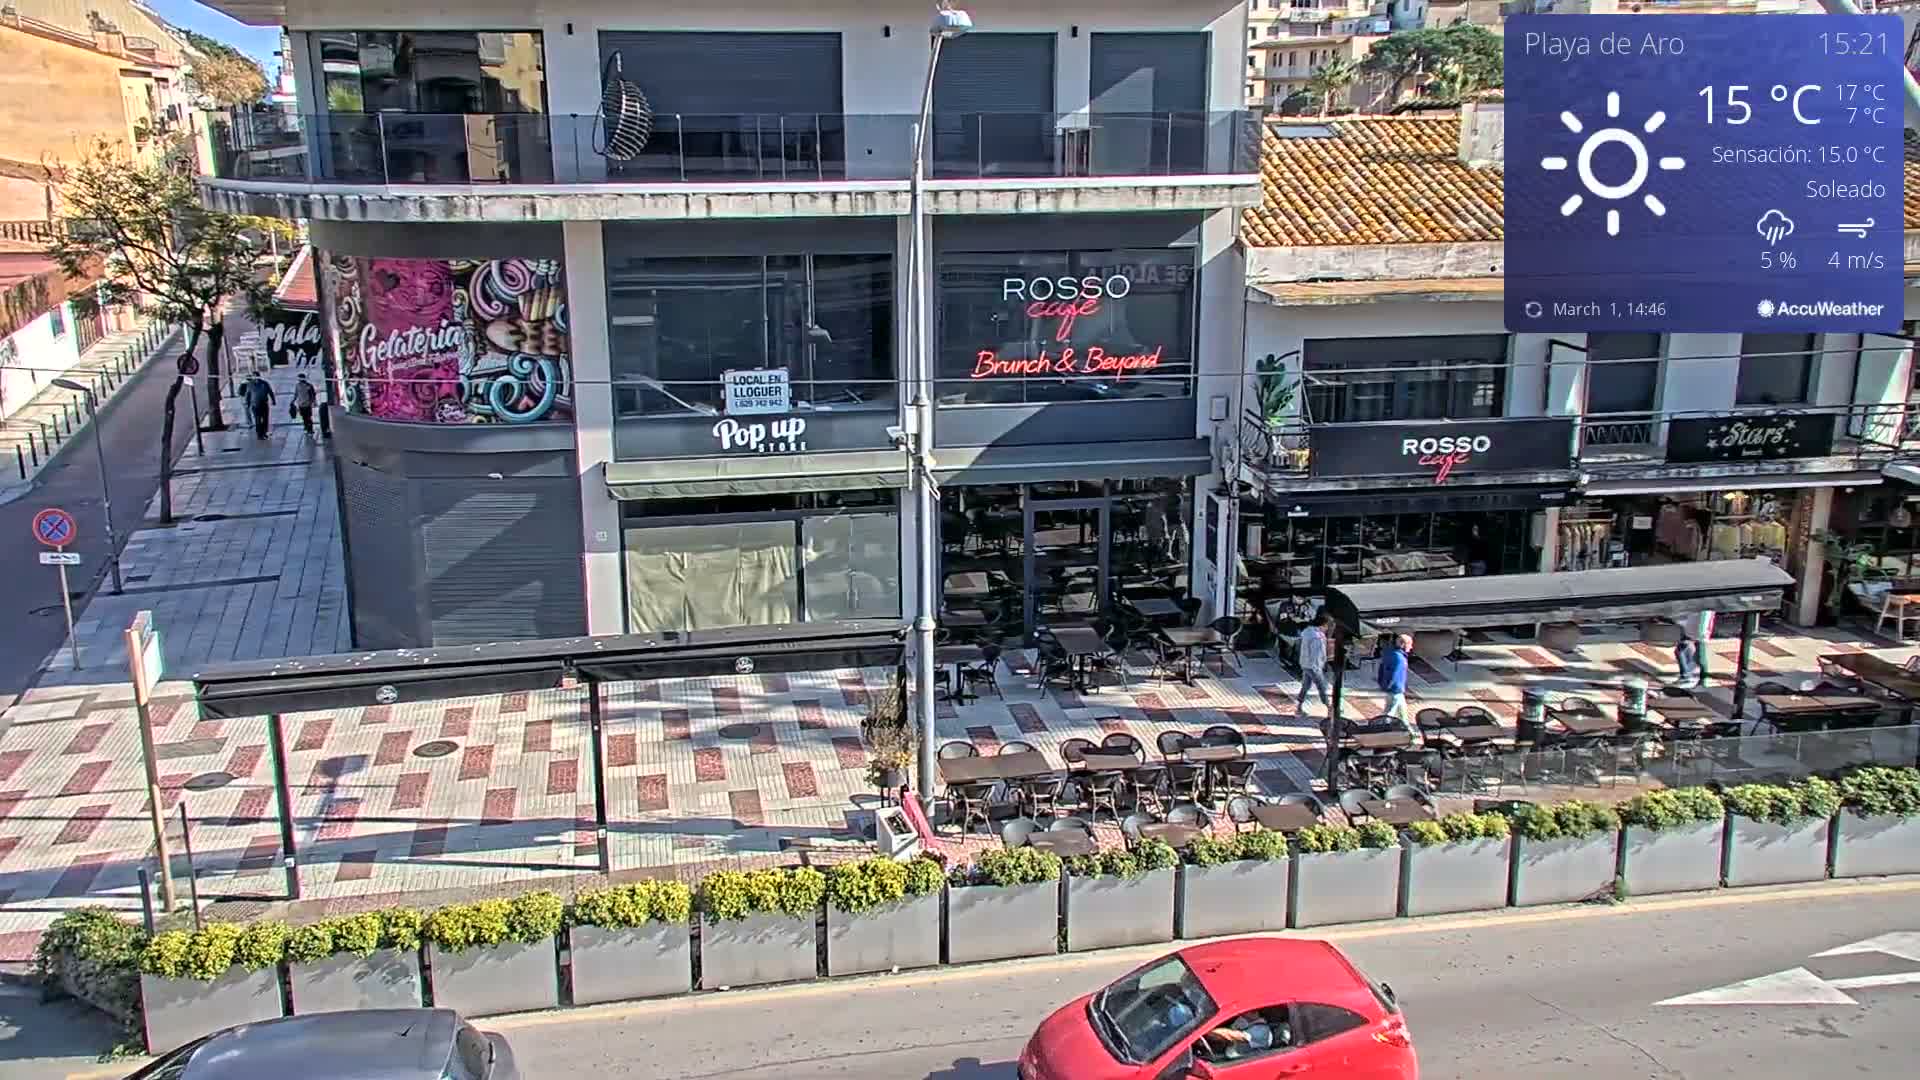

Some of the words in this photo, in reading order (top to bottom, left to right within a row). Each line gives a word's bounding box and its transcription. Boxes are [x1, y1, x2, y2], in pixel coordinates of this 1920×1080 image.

[1003, 275, 1131, 301] ROSSO
[360, 318, 463, 373] Gelateria
[971, 350, 1050, 378] Brunch
[1054, 347, 1077, 373] &
[1080, 345, 1162, 381] Beyond
[733, 375, 766, 386] LOCAL
[768, 374, 782, 384] EN
[734, 385, 782, 398] LLOGUER
[712, 418, 766, 450] Pop
[771, 417, 806, 443] up
[1402, 435, 1491, 455] ROSSO
[758, 441, 807, 453] STORE
